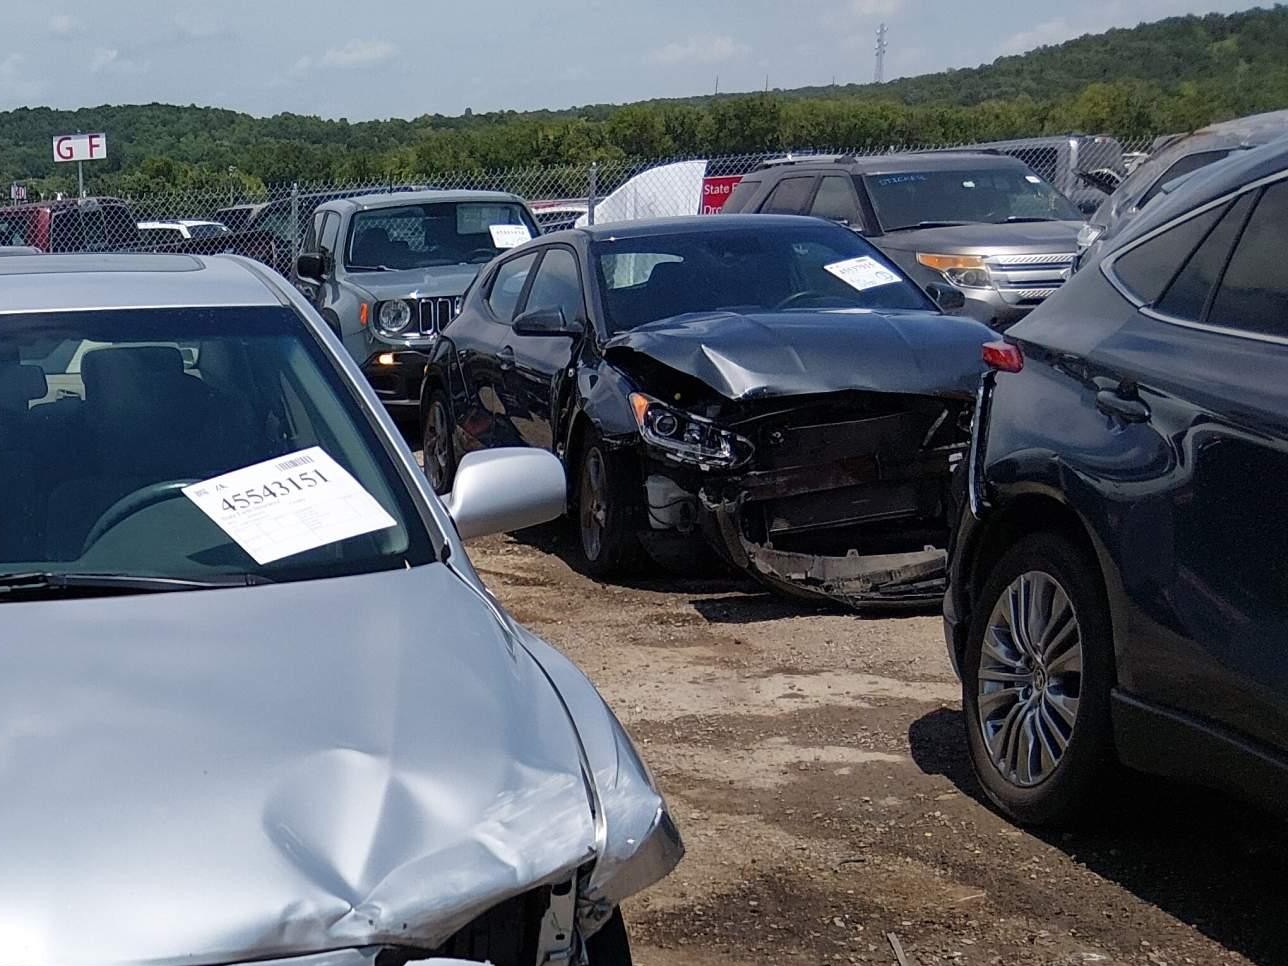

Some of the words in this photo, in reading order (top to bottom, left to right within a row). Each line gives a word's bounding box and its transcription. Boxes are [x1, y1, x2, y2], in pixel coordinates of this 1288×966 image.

[56, 136, 73, 160] G
[88, 134, 100, 158] F
[704, 183, 730, 195] State
[221, 469, 329, 512] 45543151
